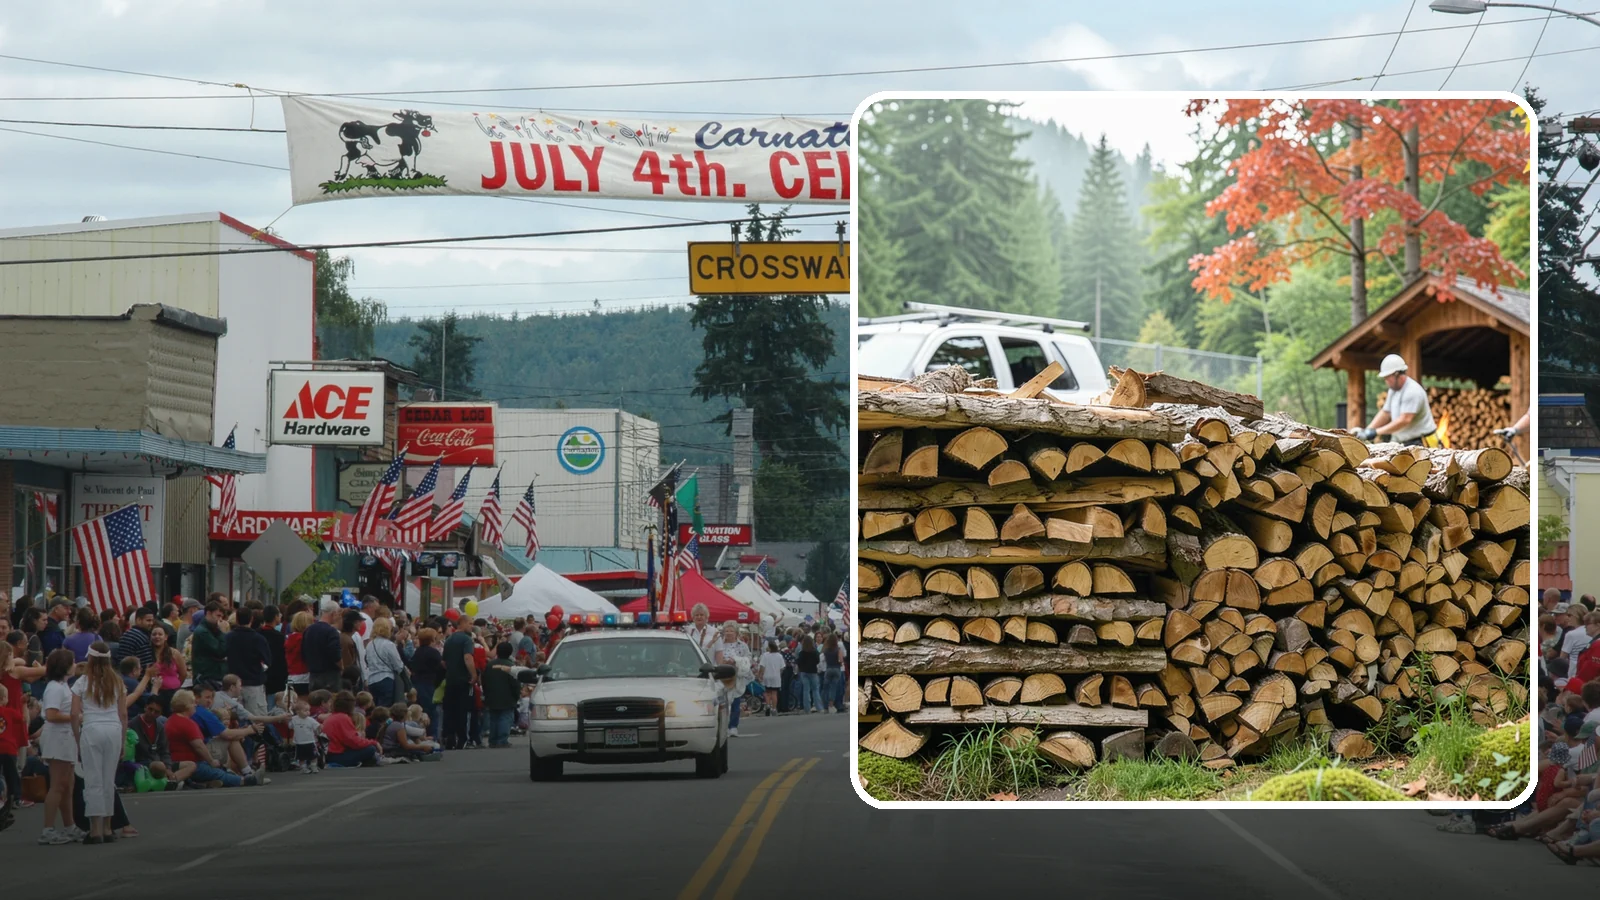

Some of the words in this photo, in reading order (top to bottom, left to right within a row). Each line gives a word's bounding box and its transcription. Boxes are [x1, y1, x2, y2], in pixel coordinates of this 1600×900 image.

[481, 141, 605, 193] JULY
[632, 150, 747, 198] 4th.
[696, 254, 850, 280] CROSSWA
[282, 380, 374, 420] ACE
[405, 409, 453, 422] CEDAR
[461, 409, 486, 422] LOG
[283, 421, 371, 436] Hardware
[83, 484, 94, 495] St.
[95, 485, 125, 495] Vincent
[126, 485, 136, 495] de
[137, 485, 155, 496] Paul
[212, 516, 331, 536] HARDARE
[688, 526, 742, 535] CRNATION
[699, 535, 730, 544] GLASS
